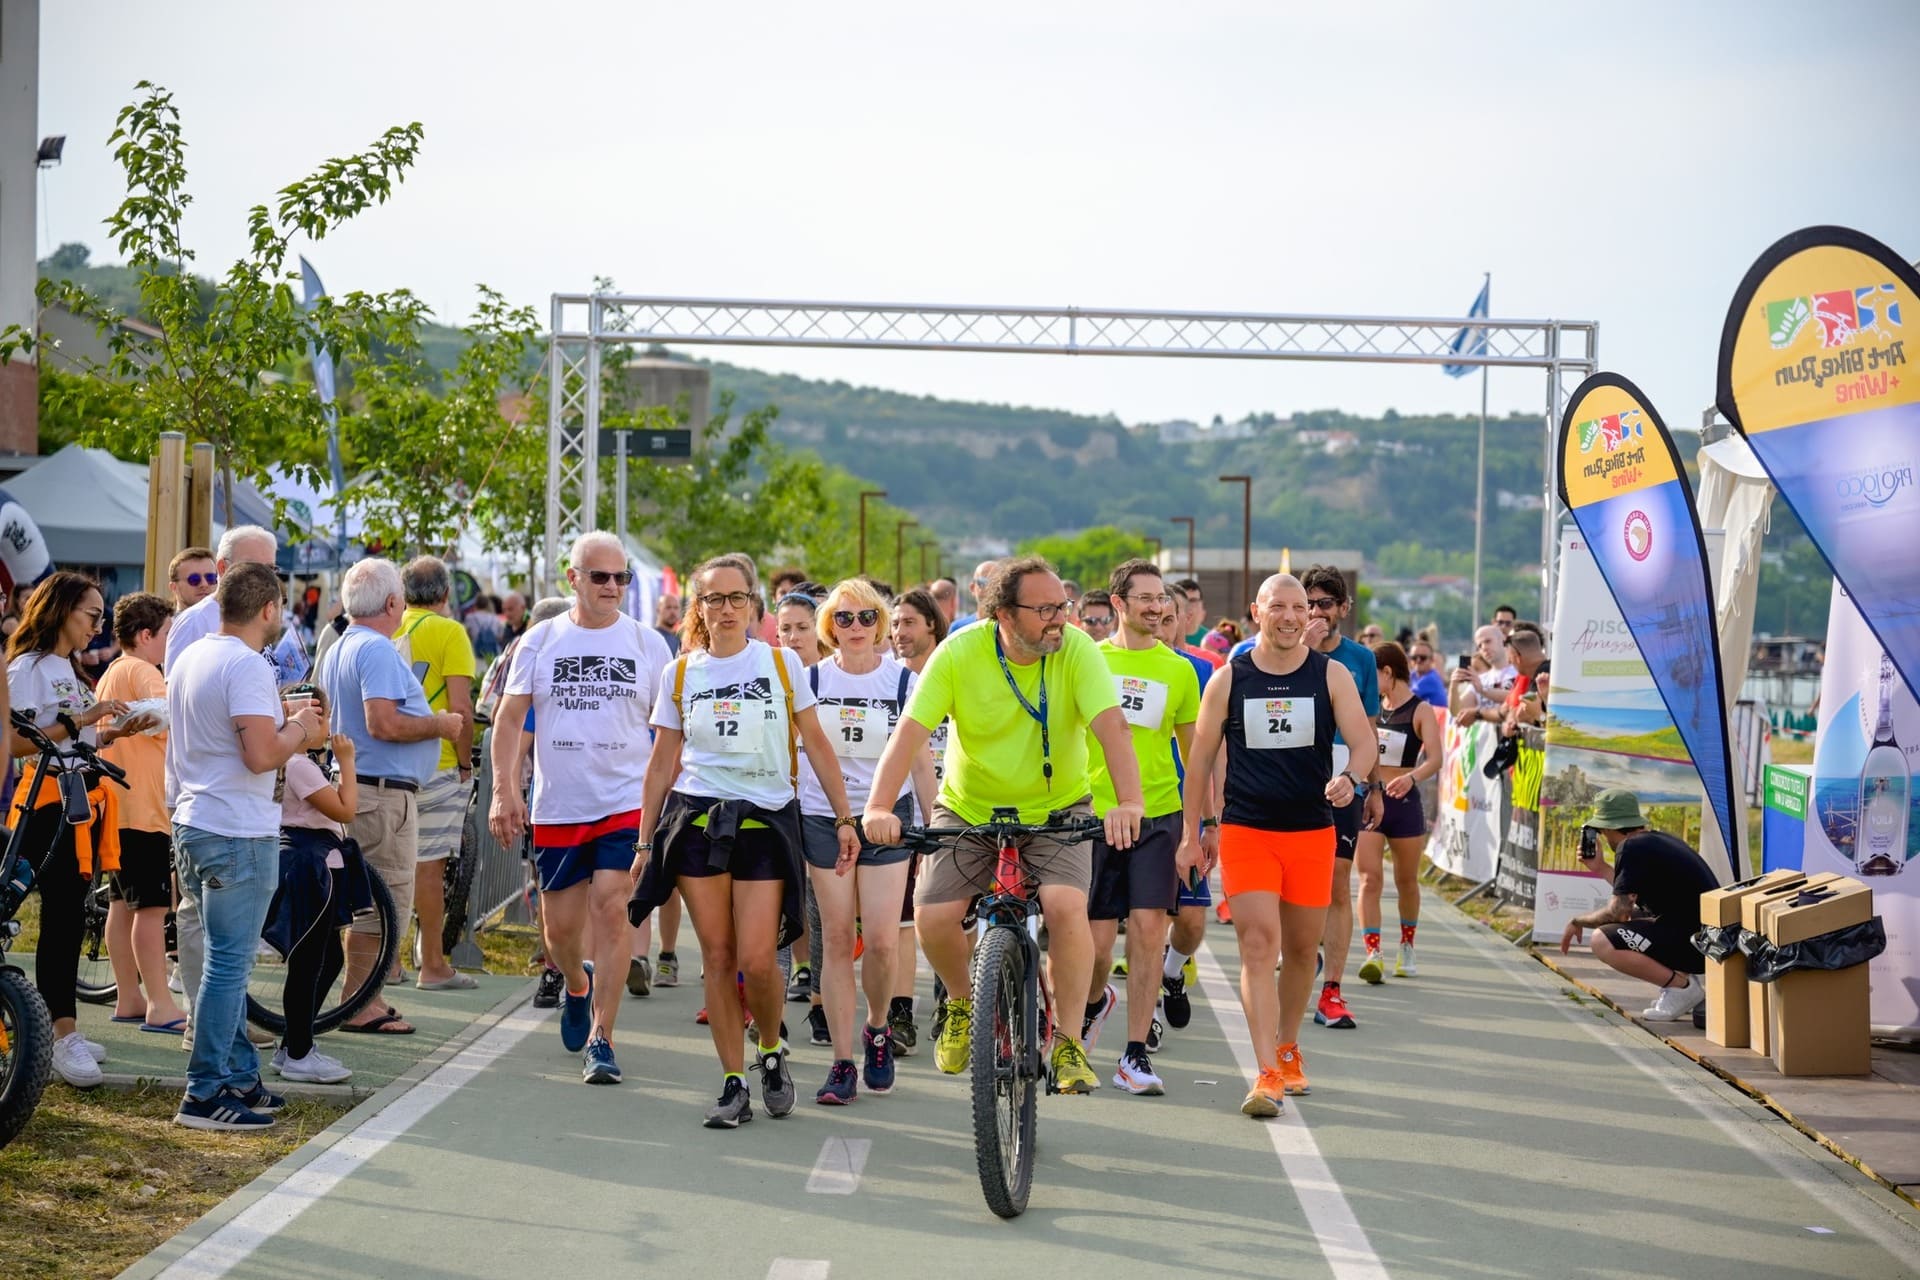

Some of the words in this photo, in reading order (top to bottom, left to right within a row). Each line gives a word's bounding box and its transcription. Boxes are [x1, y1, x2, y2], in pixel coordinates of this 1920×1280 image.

[550, 684, 577, 697] Art
[1121, 694, 1144, 711] 25
[715, 720, 739, 736] 12
[841, 726, 863, 742] 13
[1268, 718, 1292, 734] 24
